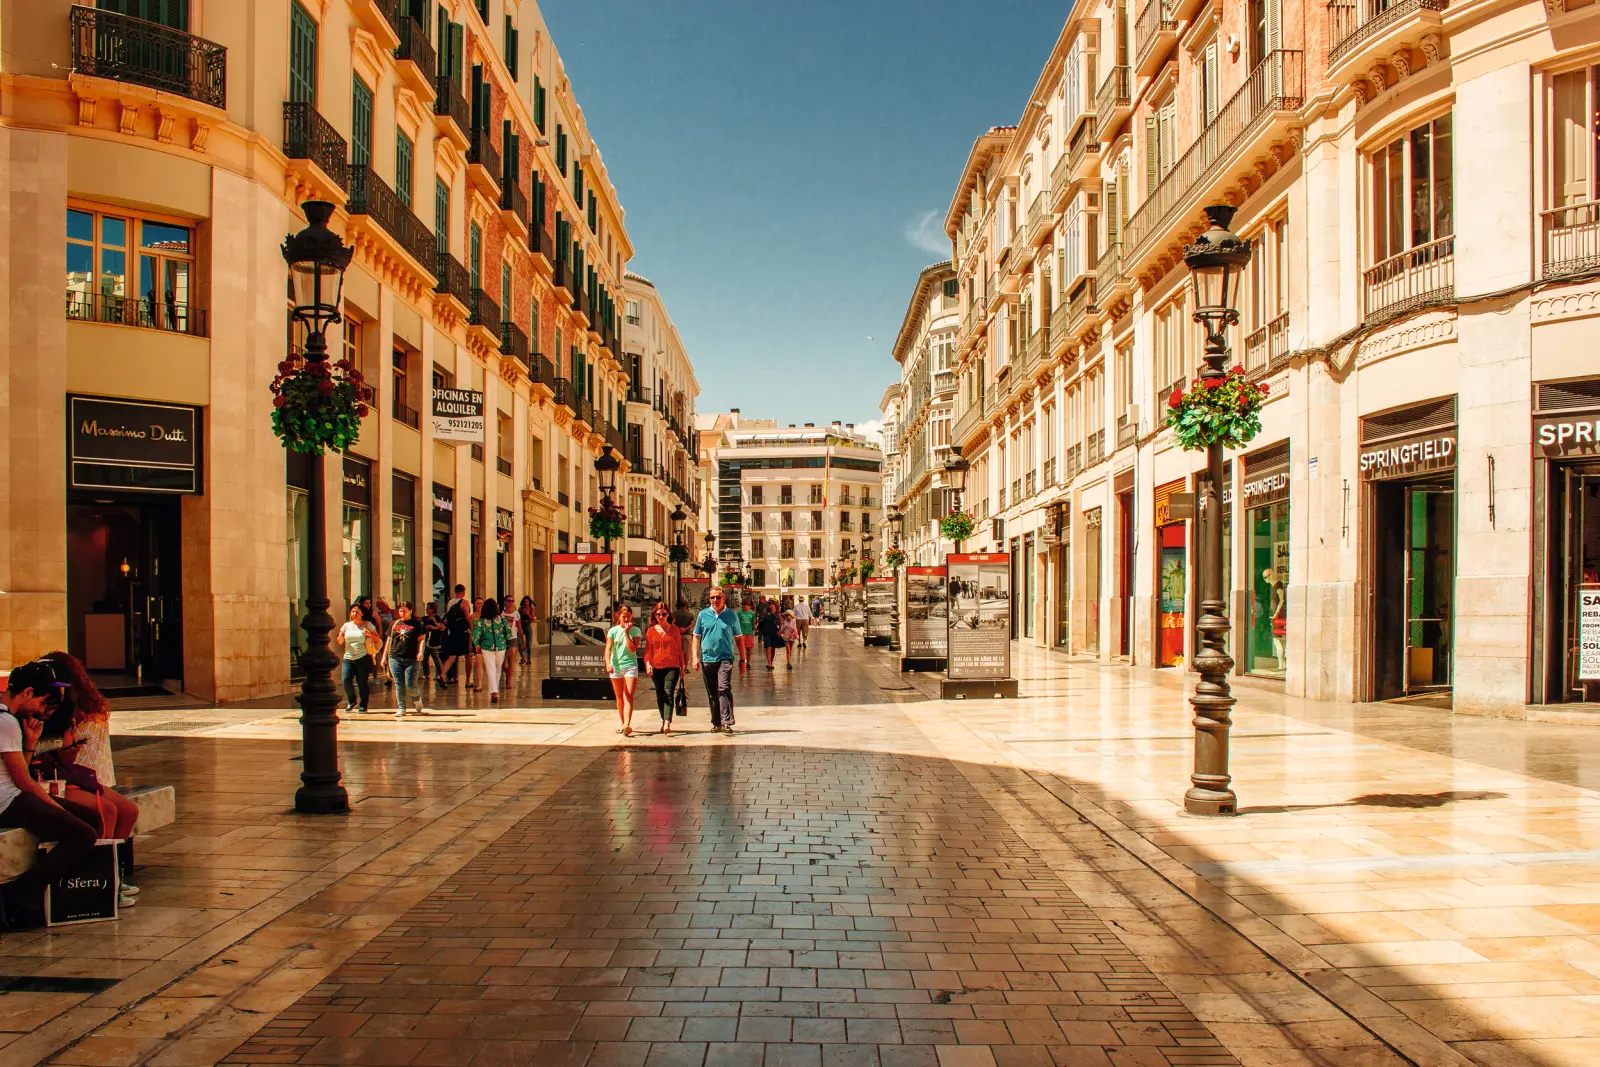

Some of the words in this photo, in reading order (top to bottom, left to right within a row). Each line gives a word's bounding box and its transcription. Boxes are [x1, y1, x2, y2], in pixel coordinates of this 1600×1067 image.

[432, 388, 470, 403] OFICINAS
[471, 392, 483, 404] EN
[436, 401, 477, 416] ALQUILER
[81, 419, 147, 439] Massimo
[149, 424, 188, 442] Dutti
[448, 419, 483, 430] 952121205
[1360, 438, 1453, 472] SPRINGFIELD
[1243, 473, 1287, 498] SPRINGFIELD
[67, 877, 100, 889] Sfera
